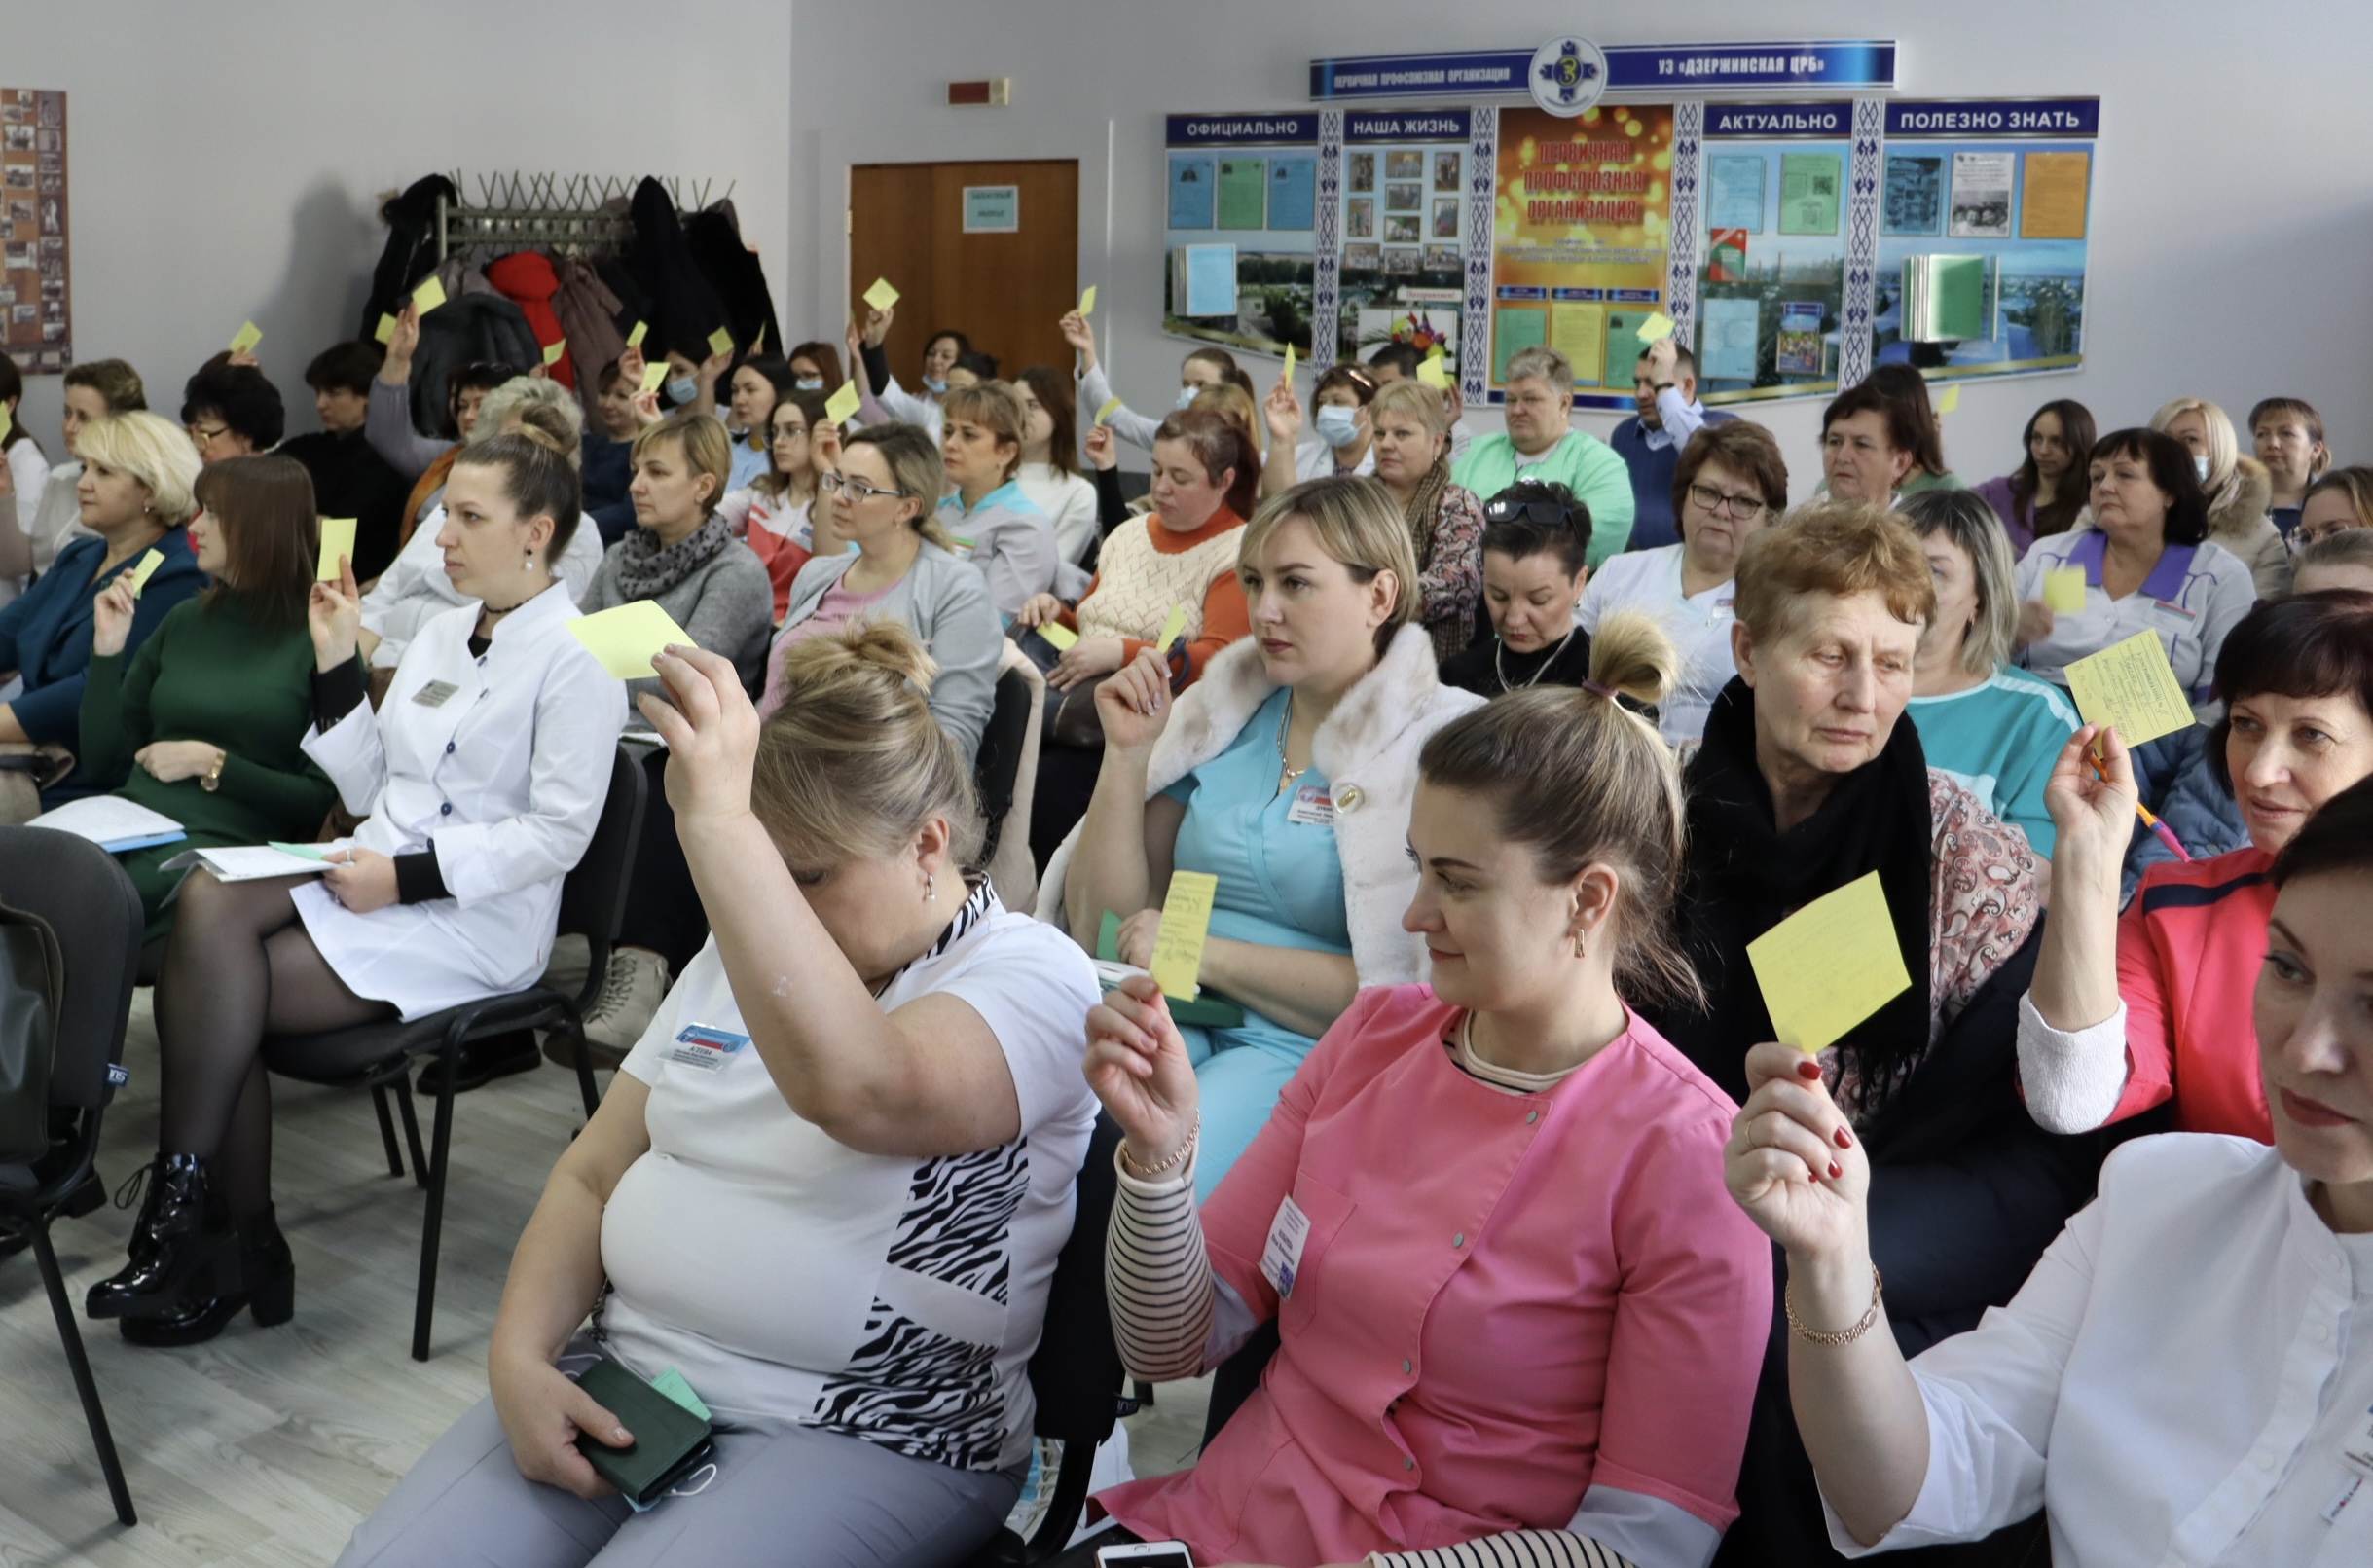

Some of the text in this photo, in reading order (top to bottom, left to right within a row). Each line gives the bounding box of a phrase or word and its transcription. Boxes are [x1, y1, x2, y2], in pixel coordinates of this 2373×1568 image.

[1658, 58, 1674, 75] УЗ
[1789, 55, 1825, 74] ЦРБ»
[1380, 70, 1445, 86] ПРОФСОЮЗНАЯ
[1447, 67, 1510, 83] ОРГАНИЗАЦИЯ
[1186, 121, 1298, 137] ОФИЦИАЛЬНО
[1353, 119, 1460, 134] НАША ЖИЗНЬ
[1718, 113, 1837, 130] АКТУАЛЬНО
[1900, 111, 2080, 128] ПОЛЕЗНО ЗНАТЬ
[1540, 141, 1631, 164] ПЕРВИЧНАЯ
[1524, 170, 1644, 192] ПРОФСОЮЗНАЯ
[1527, 200, 1638, 223] ОРГАНИЗАЦИЯ
